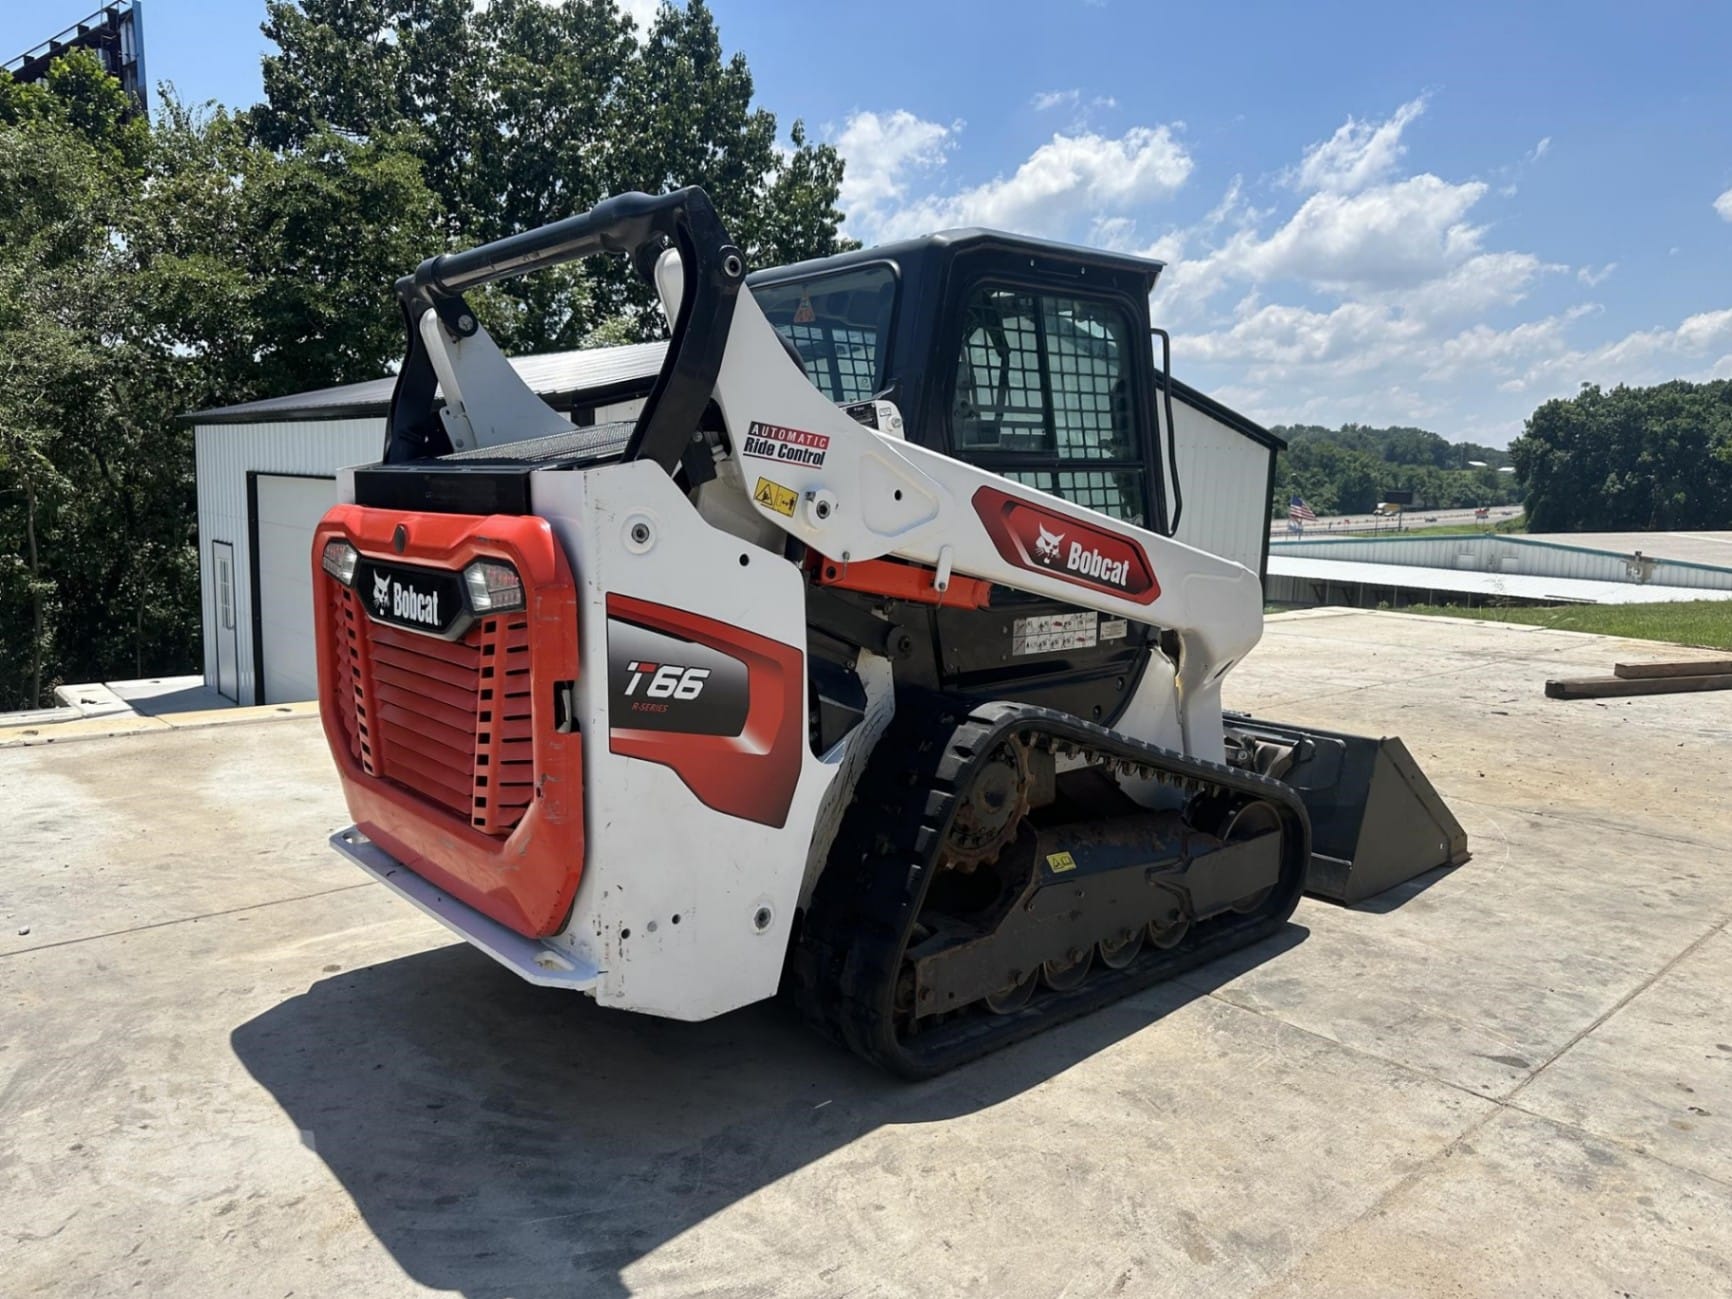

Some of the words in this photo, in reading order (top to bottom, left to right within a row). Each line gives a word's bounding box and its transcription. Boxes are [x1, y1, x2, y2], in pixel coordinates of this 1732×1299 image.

[743, 437, 775, 456] Ride
[777, 443, 826, 466] Control
[751, 423, 828, 448] AUTOMATIC
[1066, 541, 1130, 587] Bobcat
[392, 582, 440, 627] Bobcat
[624, 661, 712, 700] T66
[631, 702, 670, 713] R-SERIES
